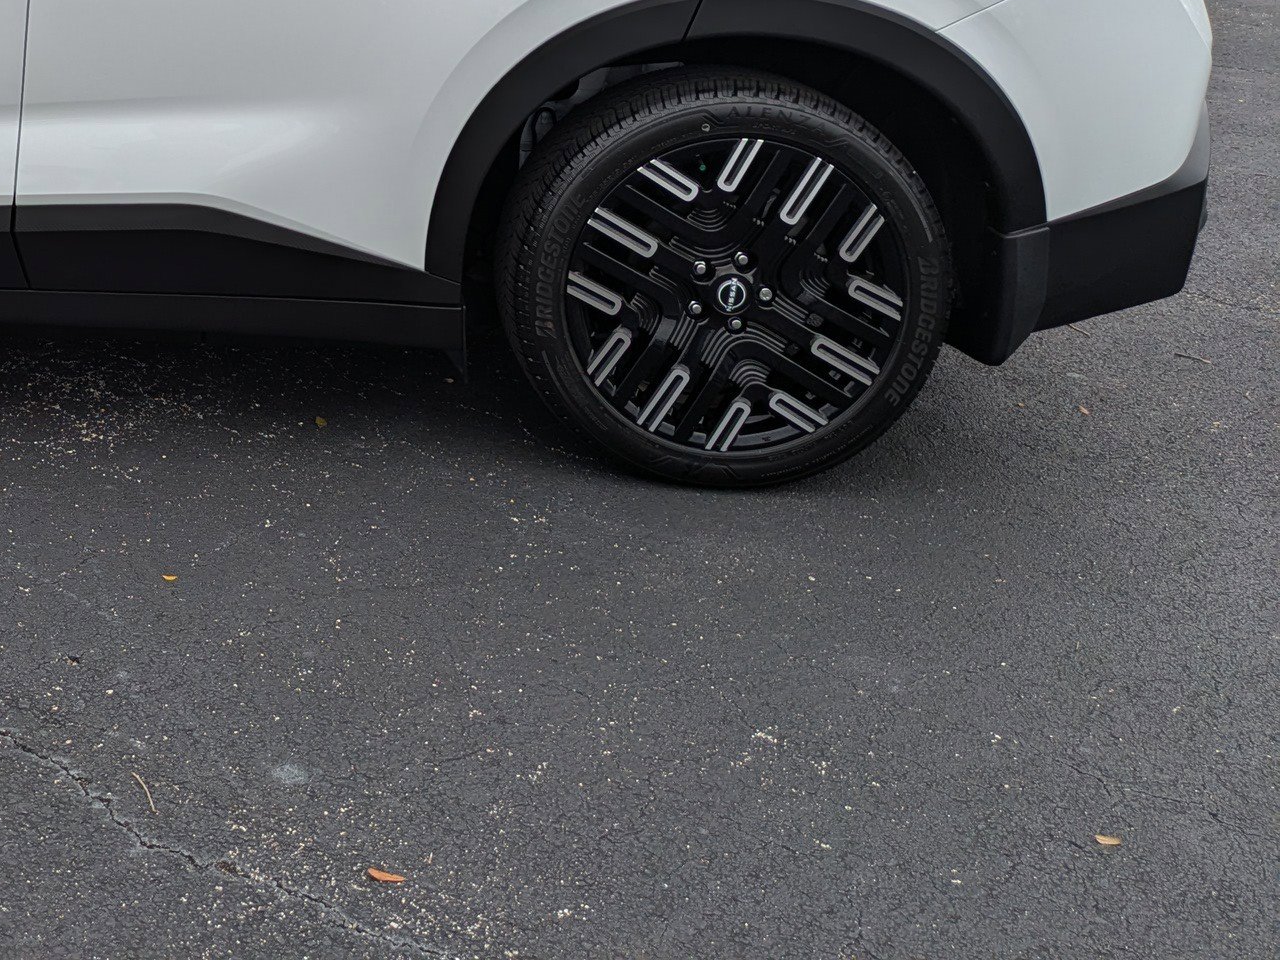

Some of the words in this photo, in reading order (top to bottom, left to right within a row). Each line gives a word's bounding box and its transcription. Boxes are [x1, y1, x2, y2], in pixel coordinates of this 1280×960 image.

[727, 105, 827, 136] ALENZA
[535, 191, 587, 340] BRIDGESTONE
[725, 277, 739, 312] NISSAN
[884, 256, 939, 408] BRIDGESTONE
